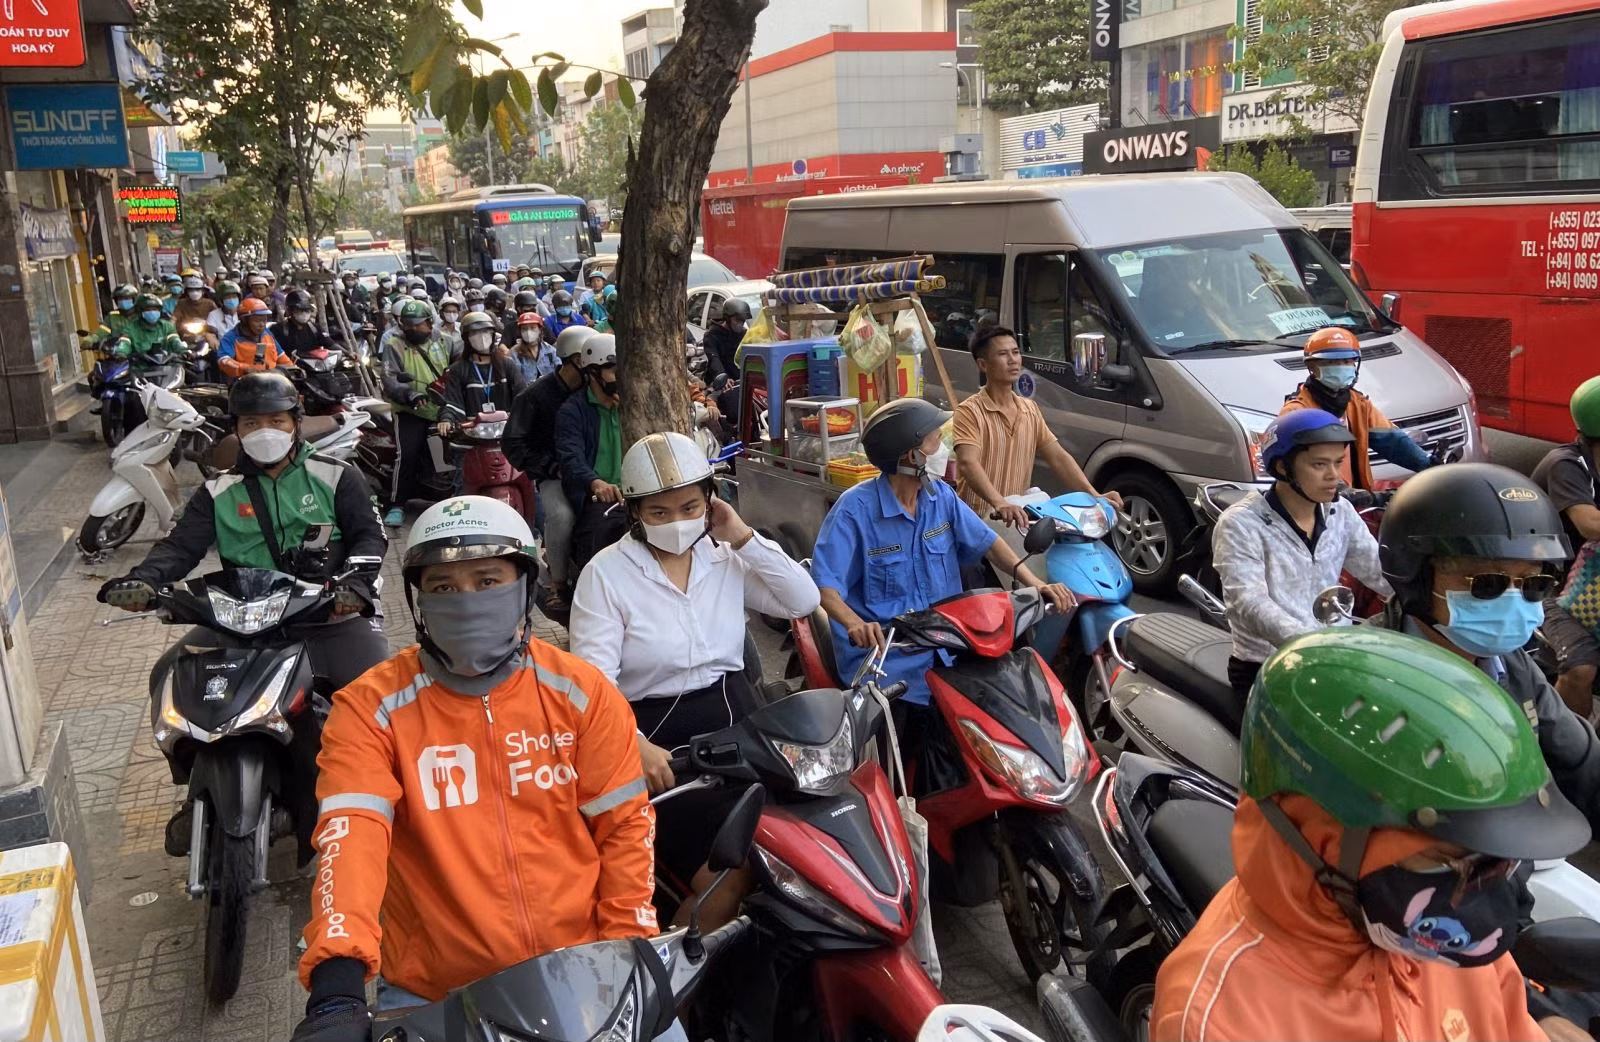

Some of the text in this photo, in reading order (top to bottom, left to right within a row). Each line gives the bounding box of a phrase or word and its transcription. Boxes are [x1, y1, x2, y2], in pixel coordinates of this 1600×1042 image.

[27, 28, 44, 37] TƯ
[46, 28, 70, 37] DUY
[11, 42, 55, 53] HOA KỲ
[12, 109, 117, 132] SUNOFF
[41, 136, 66, 146] TRANG
[1103, 130, 1189, 163] ONWAYS
[708, 197, 736, 215] viettel
[530, 211, 542, 220] AN
[1549, 211, 1600, 230] (+855) 023
[1521, 241, 1538, 257] TEL
[1547, 232, 1600, 250] (+855) 097
[496, 262, 508, 271] 04
[1546, 252, 1571, 270] (+84)
[1574, 252, 1588, 269] 08
[1546, 272, 1598, 290] (+84) 0909
[1033, 362, 1066, 375] TRANSIT
[424, 520, 456, 534] Doctor
[457, 518, 488, 527] Acnes
[508, 759, 579, 797] Foo
[830, 804, 857, 818] HONDA
